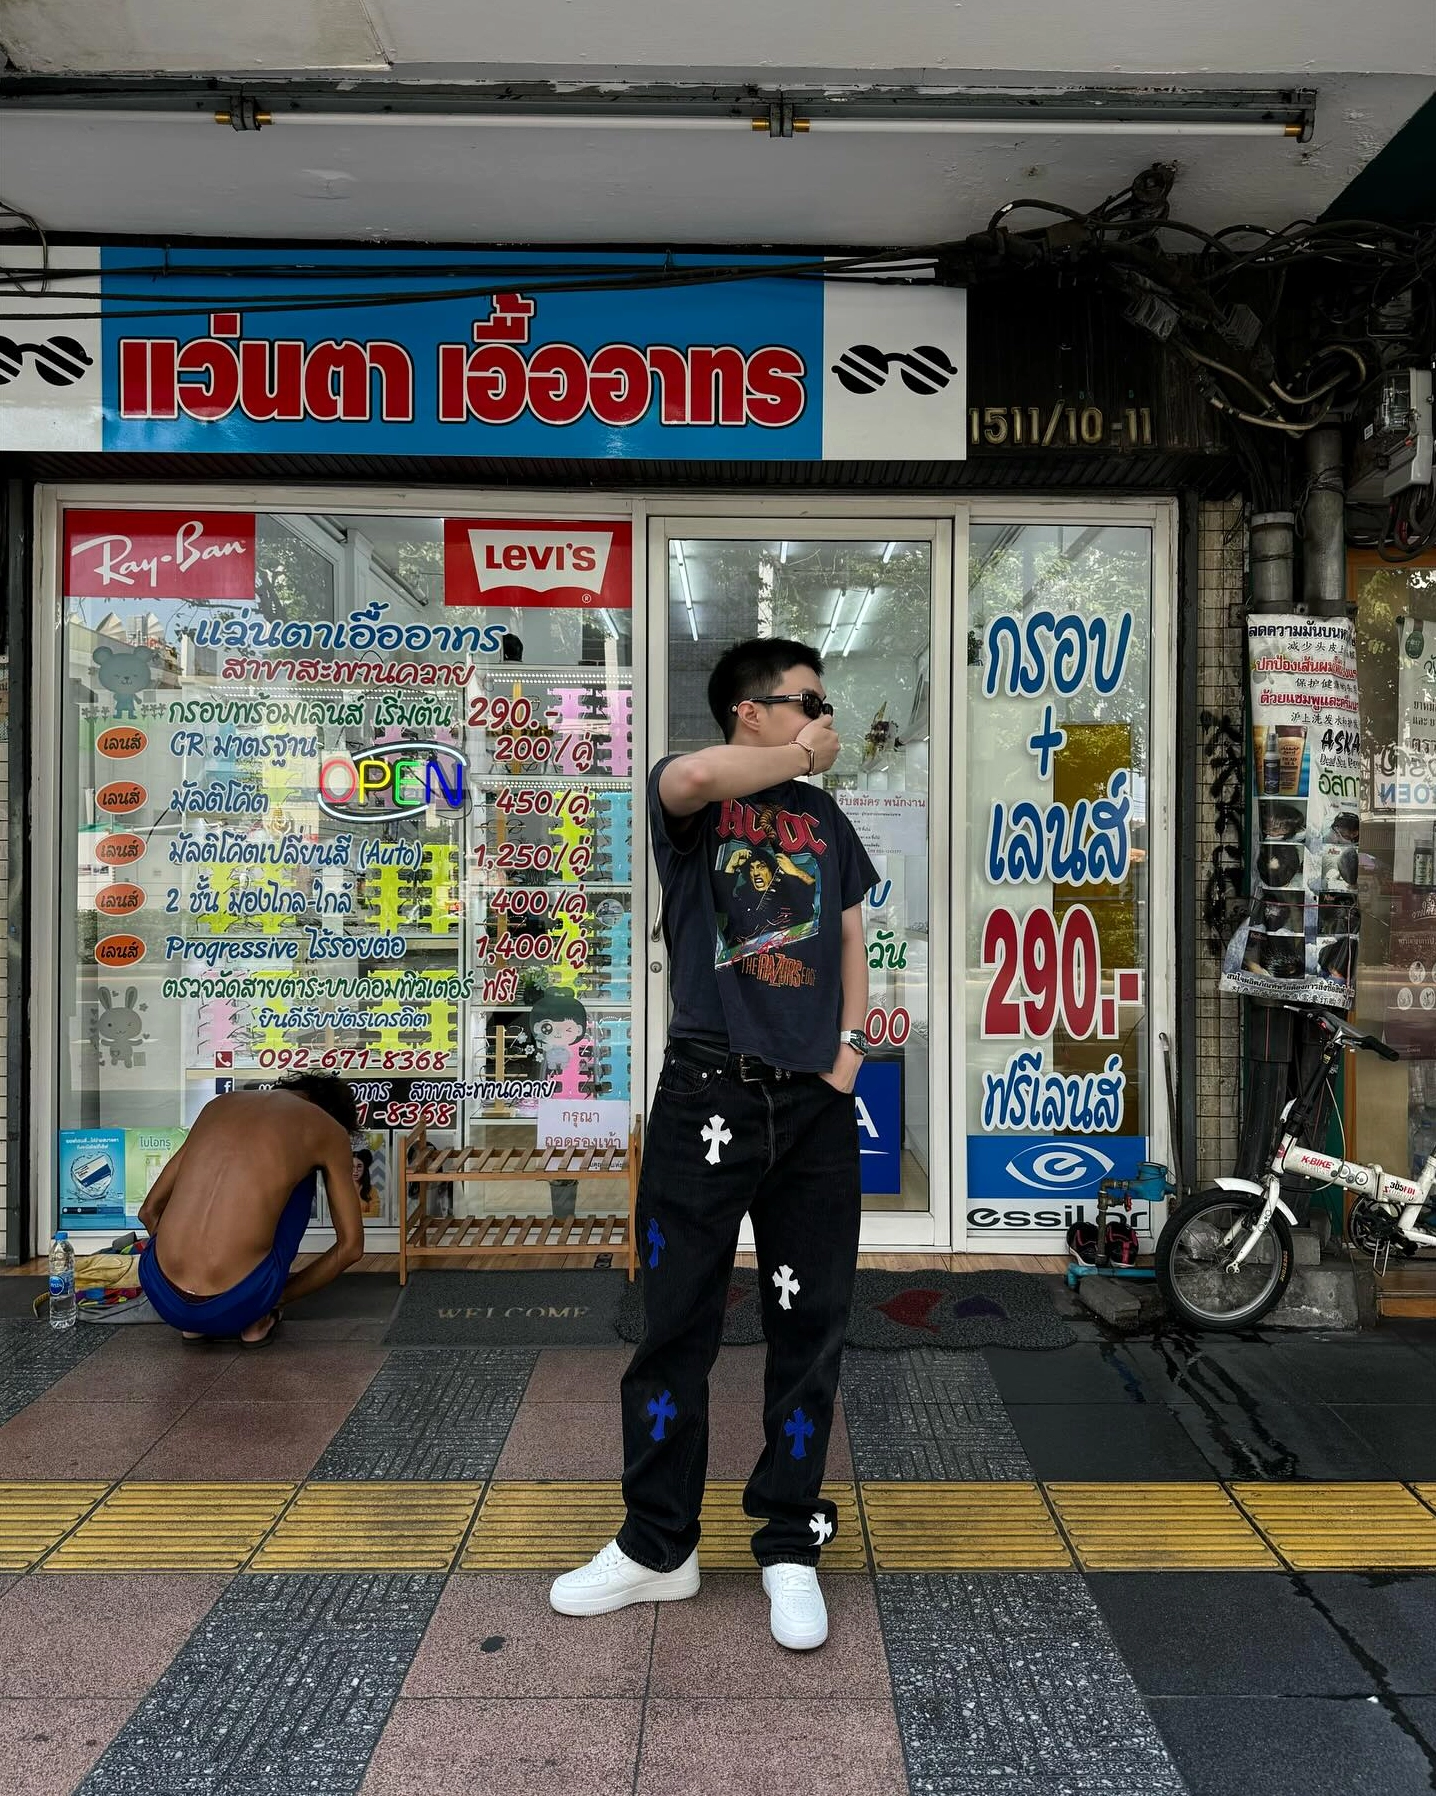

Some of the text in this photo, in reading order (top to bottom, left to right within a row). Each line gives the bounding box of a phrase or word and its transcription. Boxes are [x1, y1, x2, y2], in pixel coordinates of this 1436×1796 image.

[119, 293, 808, 428] แว่นตา เอื้ออาทร
[71, 520, 247, 588] Ray-Ban
[195, 601, 507, 651] แว่นตาเอื้ออาทร
[982, 607, 1134, 698] กรอบ
[221, 657, 476, 687] สาขาสะพานควาย
[168, 692, 366, 727] กรอบพร้อมเลนส์
[374, 690, 452, 728] เริ่มต้น
[103, 733, 142, 752] เลนส์
[170, 730, 594, 773] CR มาตรฐาน 200/คู่
[102, 786, 142, 807] เลนส์
[319, 757, 464, 808] OPEN
[1319, 767, 1360, 797] อัสก
[495, 786, 592, 827] 450/คู่
[838, 794, 926, 808] รับสมัคร พนักงาน
[986, 768, 1133, 886] เลนส์
[101, 838, 140, 858] เลนส์
[359, 839, 423, 872] (Auto)
[473, 836, 592, 876] 1,250/คู่
[101, 889, 140, 909] เลนส์
[165, 874, 588, 924] 2 ชั้น มองไกล-ใกล้ 400/คู่
[101, 941, 140, 959] เลนส์
[165, 927, 589, 970] Progressive ไร้รอยต่อ 1,400/คู่
[162, 967, 519, 1002] ตรวจวัดสายตาระบบคอมพิวเตอร์ ฟรี!
[258, 1006, 429, 1029] ยินดีรับบัตรเครดิต
[258, 1048, 450, 1072] 092-671-8368
[409, 1080, 556, 1100] สาขาสะพานควาย
[981, 1047, 1126, 1132] ฟรีเลนส์
[562, 1110, 600, 1128] กรุณา
